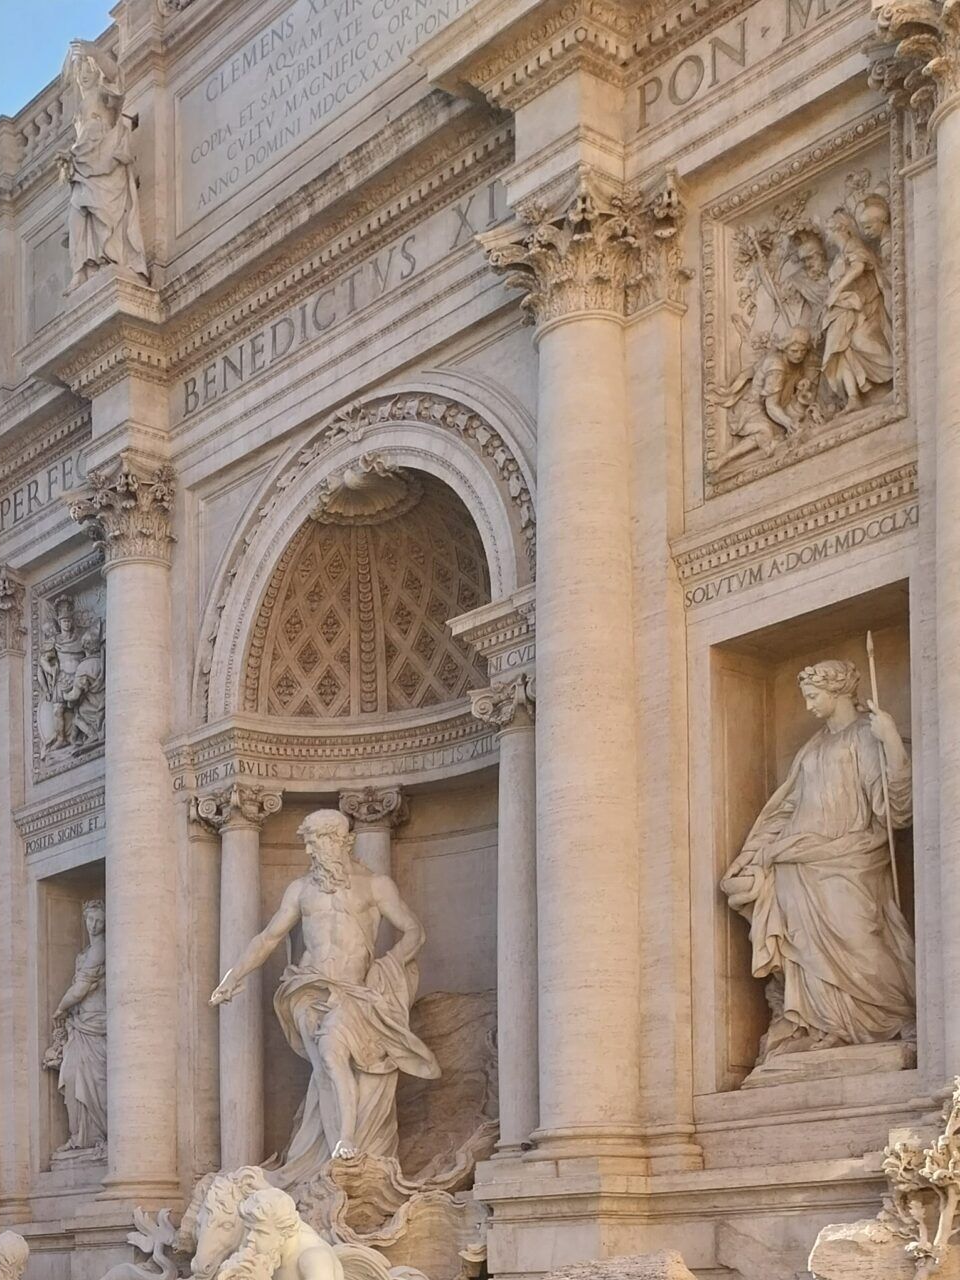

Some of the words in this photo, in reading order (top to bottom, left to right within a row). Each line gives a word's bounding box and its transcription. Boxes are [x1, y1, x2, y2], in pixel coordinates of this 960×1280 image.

[191, 123, 232, 164] COPIA
[240, 101, 256, 128] ET
[261, 17, 362, 111] SALVBRITATE
[206, 12, 294, 102] CLEMENS
[227, 111, 276, 161] CVLTV
[285, 31, 379, 118] MAGNIFICO
[265, 21, 323, 82] AQVAM
[198, 166, 239, 210] ANNO
[245, 117, 300, 174] DOMINI
[183, 234, 416, 418] BENEDICTVS
[450, 178, 500, 251] XI
[685, 564, 763, 608] SOLVTVM
[25, 832, 55, 857] POSITIS
[58, 822, 84, 842] SIGNIS
[88, 816, 99, 833] ET
